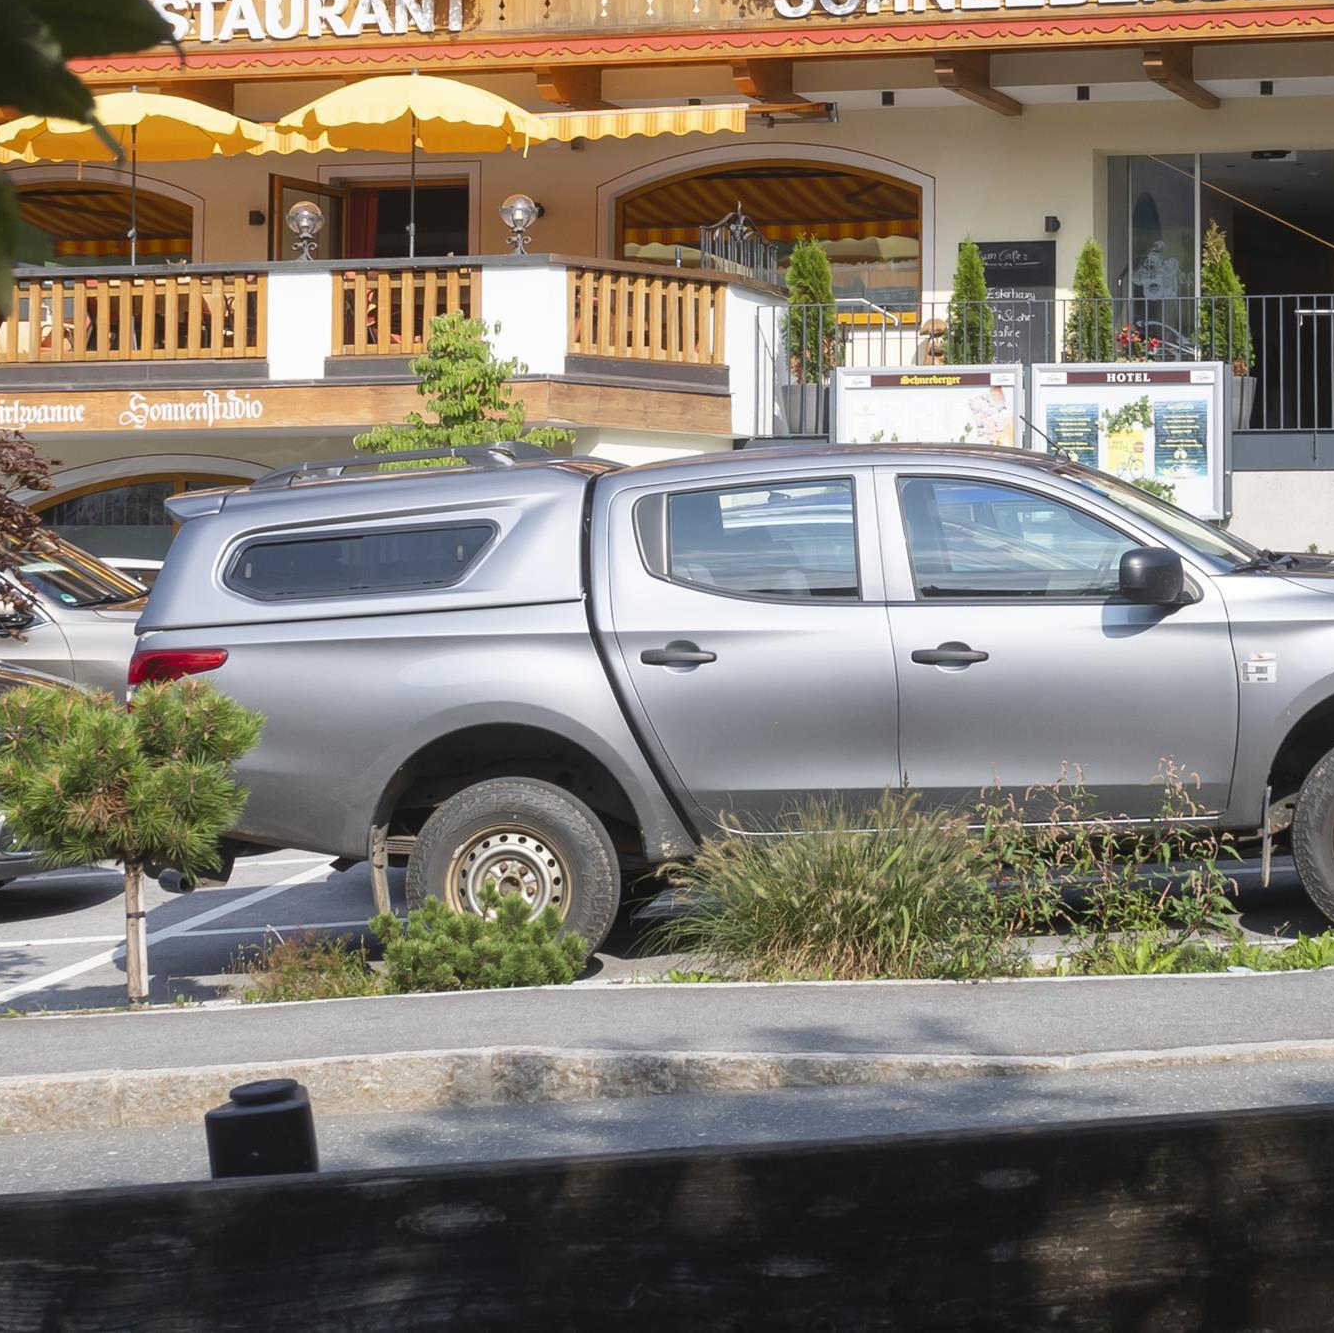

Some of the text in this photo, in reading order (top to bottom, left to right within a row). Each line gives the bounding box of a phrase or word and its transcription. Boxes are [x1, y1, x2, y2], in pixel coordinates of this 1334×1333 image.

[980, 252, 997, 261] um
[899, 375, 962, 386] Schneeberger
[1106, 372, 1151, 383] HOTEL
